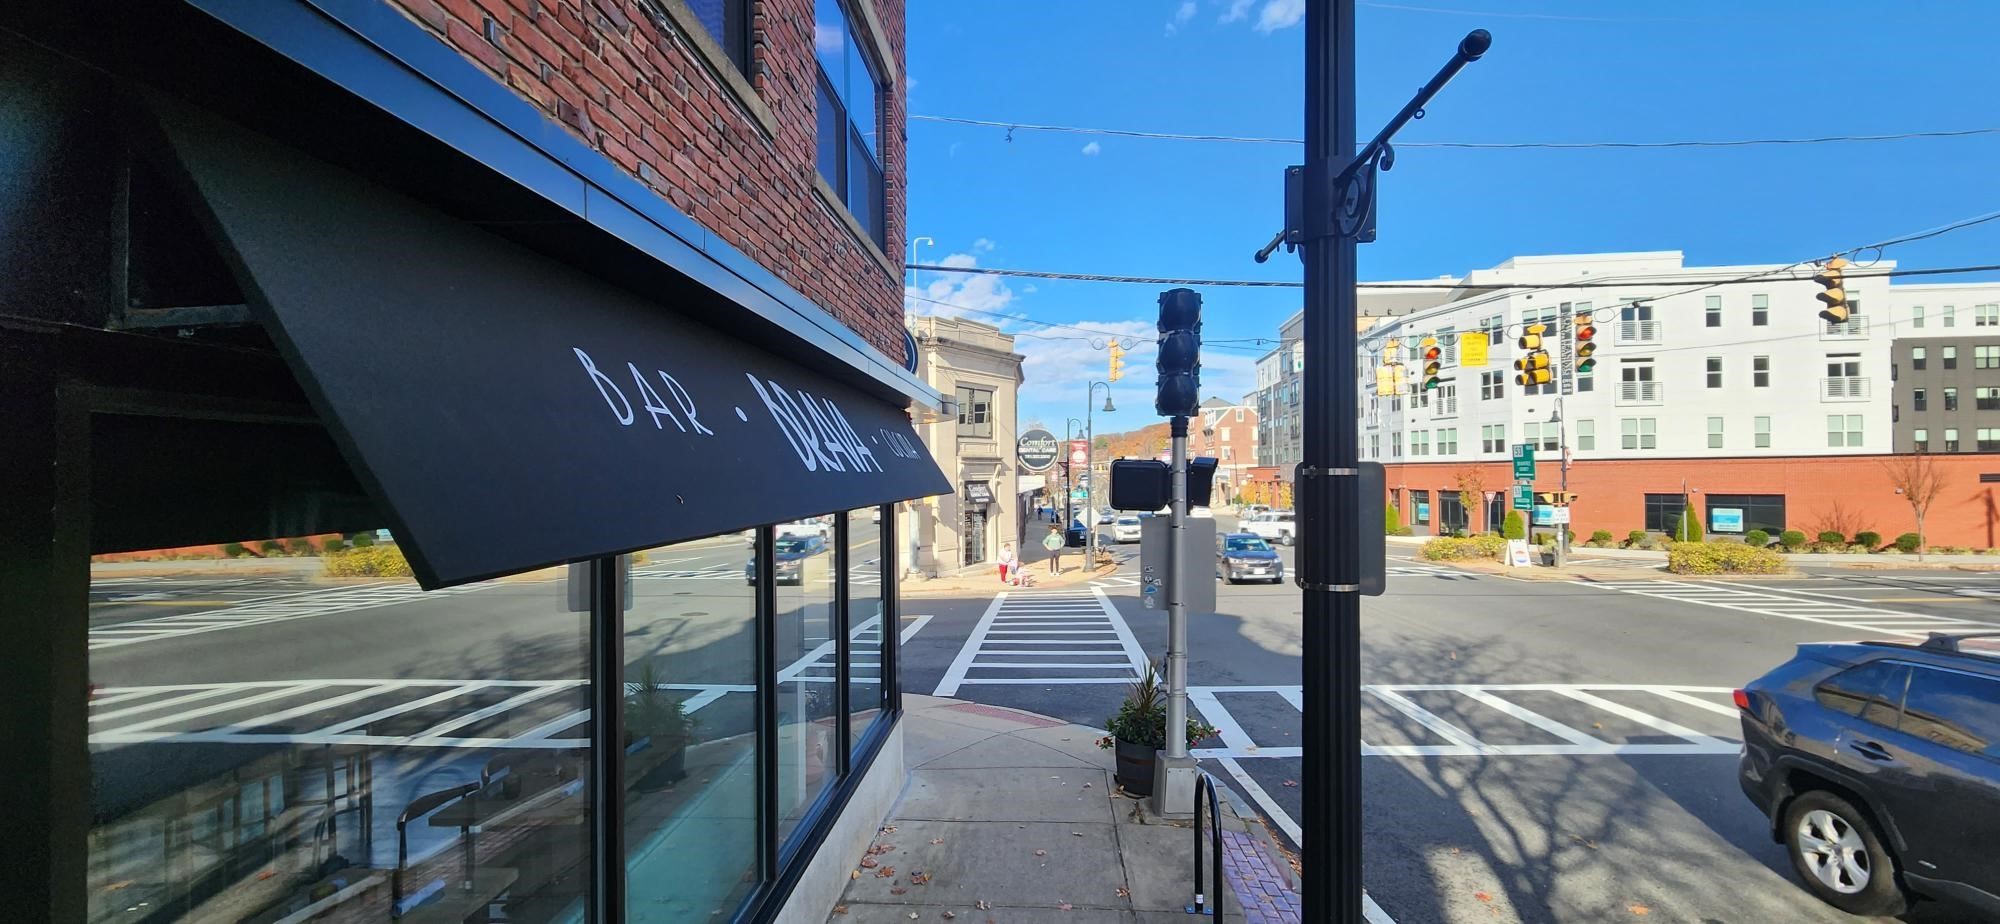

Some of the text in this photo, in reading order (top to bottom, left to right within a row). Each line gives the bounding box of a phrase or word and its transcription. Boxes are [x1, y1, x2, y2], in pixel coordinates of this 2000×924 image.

[572, 346, 714, 436] BAR
[745, 372, 883, 473] BRAVA
[1020, 436, 1056, 449] Comfort
